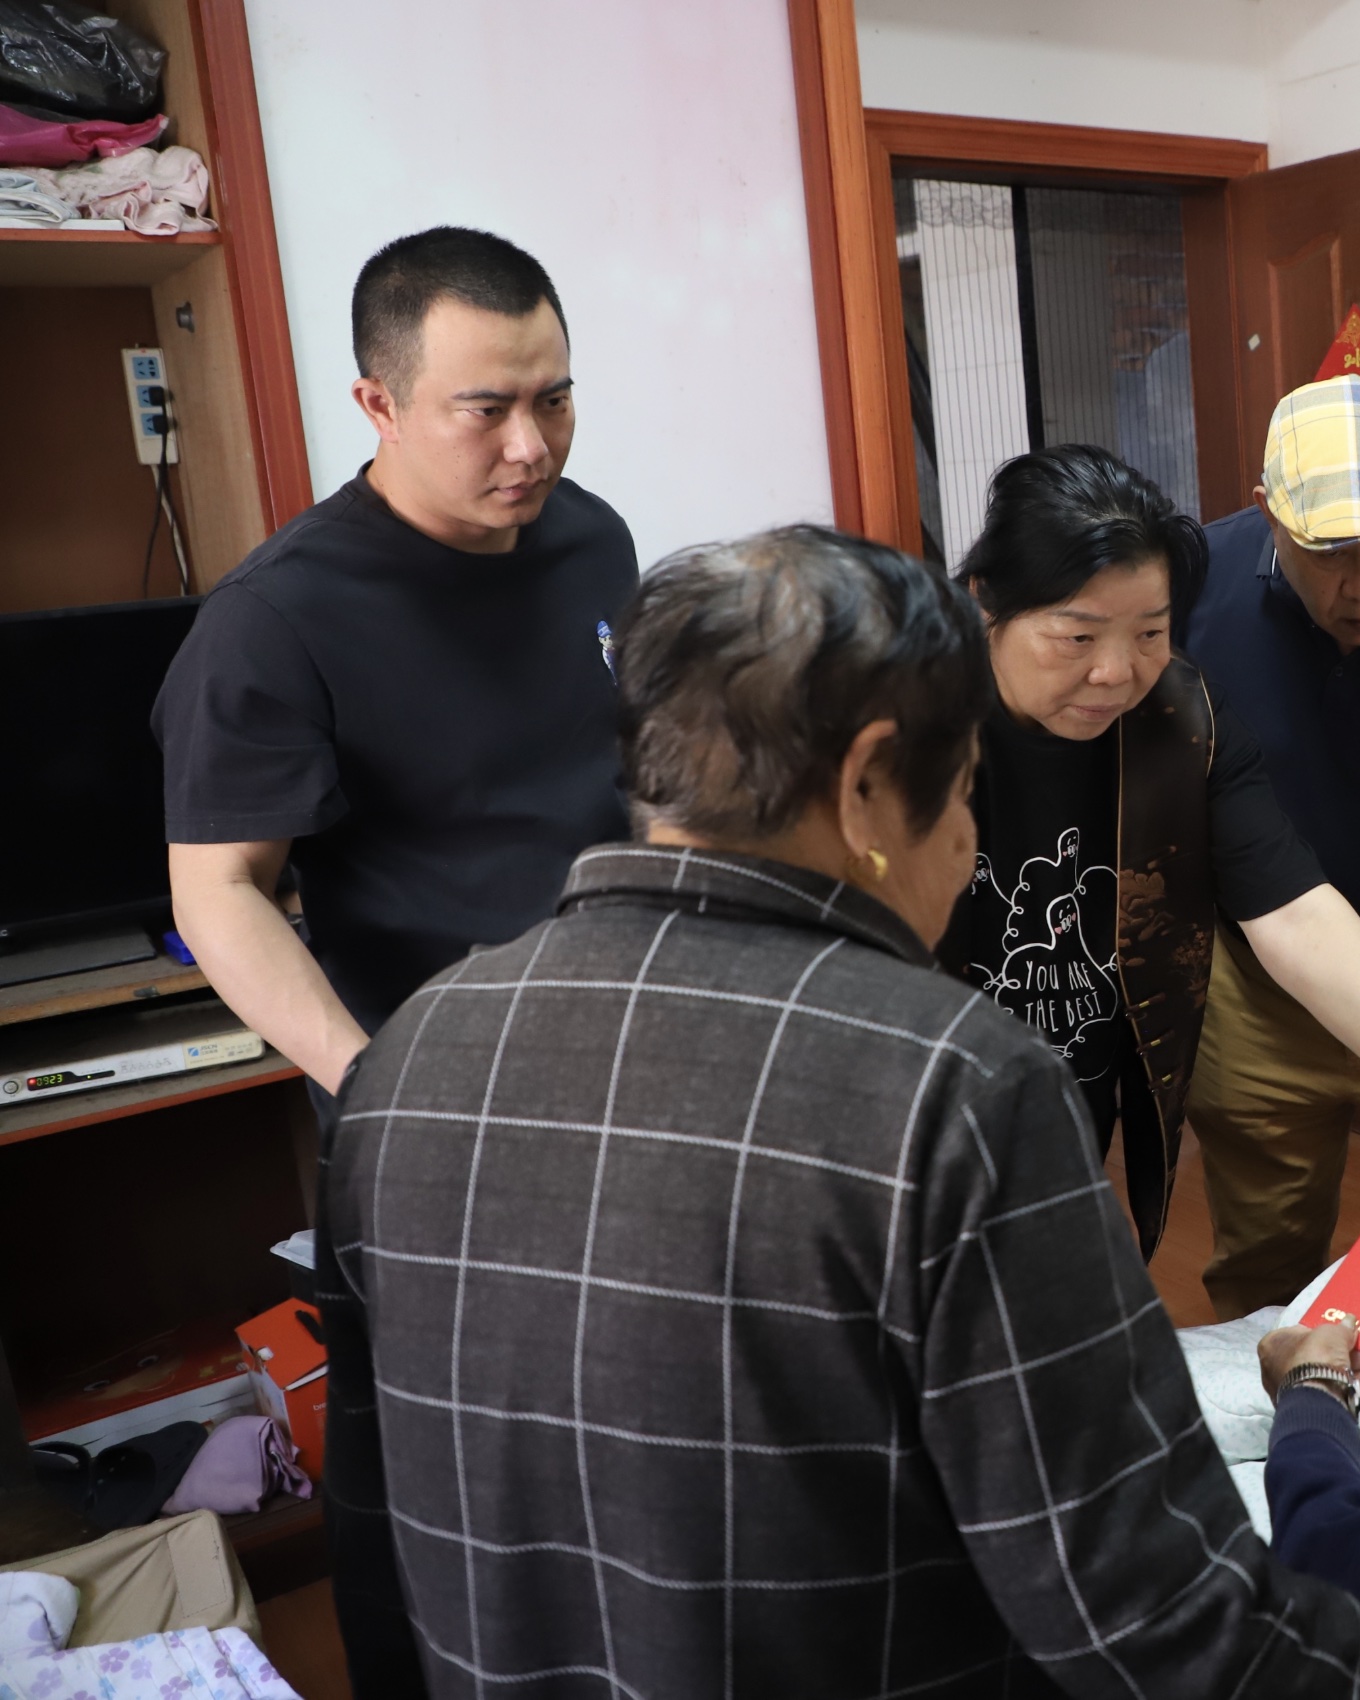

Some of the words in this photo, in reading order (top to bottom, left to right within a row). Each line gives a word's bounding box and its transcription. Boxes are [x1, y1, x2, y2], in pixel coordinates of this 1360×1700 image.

[1025, 961, 1060, 991] YOU
[1068, 961, 1096, 990] ARE
[1025, 999, 1059, 1033] THE
[1066, 992, 1102, 1027] BEST
[36, 1074, 63, 1087] 0923
